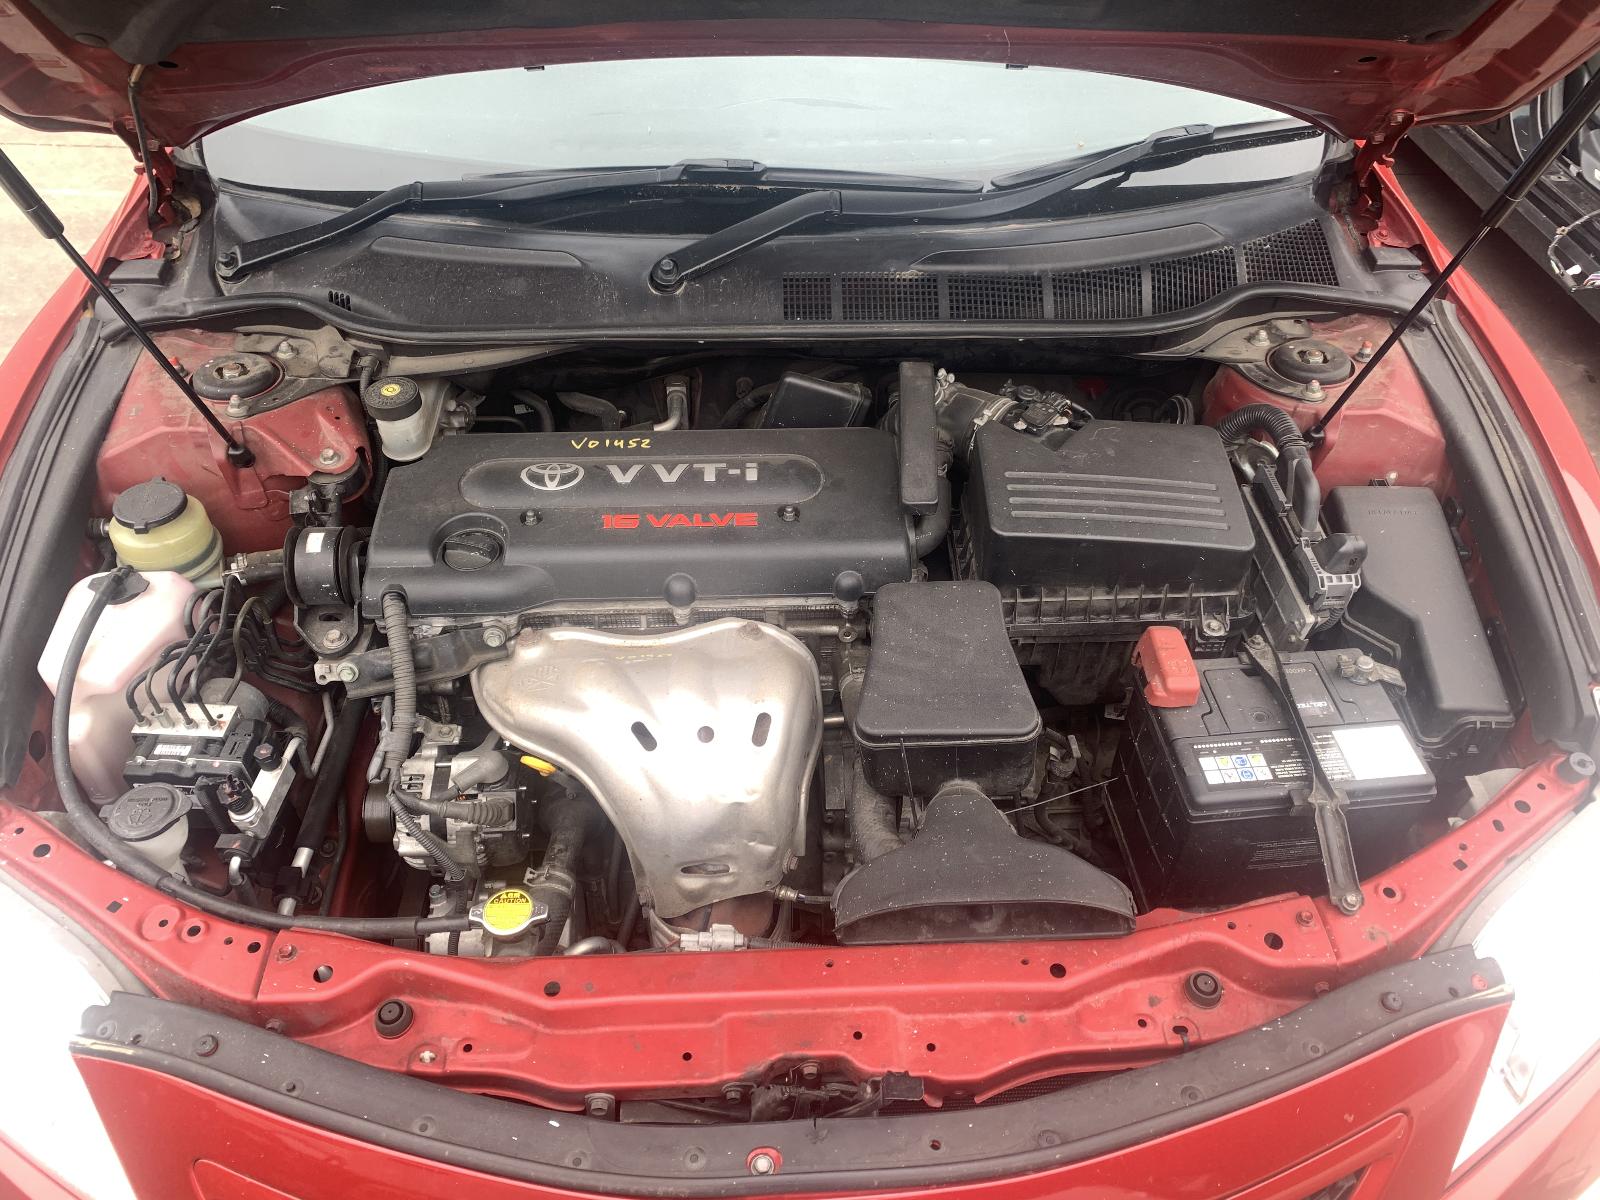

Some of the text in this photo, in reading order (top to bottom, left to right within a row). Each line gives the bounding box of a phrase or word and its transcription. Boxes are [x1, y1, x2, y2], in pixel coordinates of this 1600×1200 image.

[606, 463, 758, 483] VVT-i
[602, 512, 759, 529] 16 VALVE
